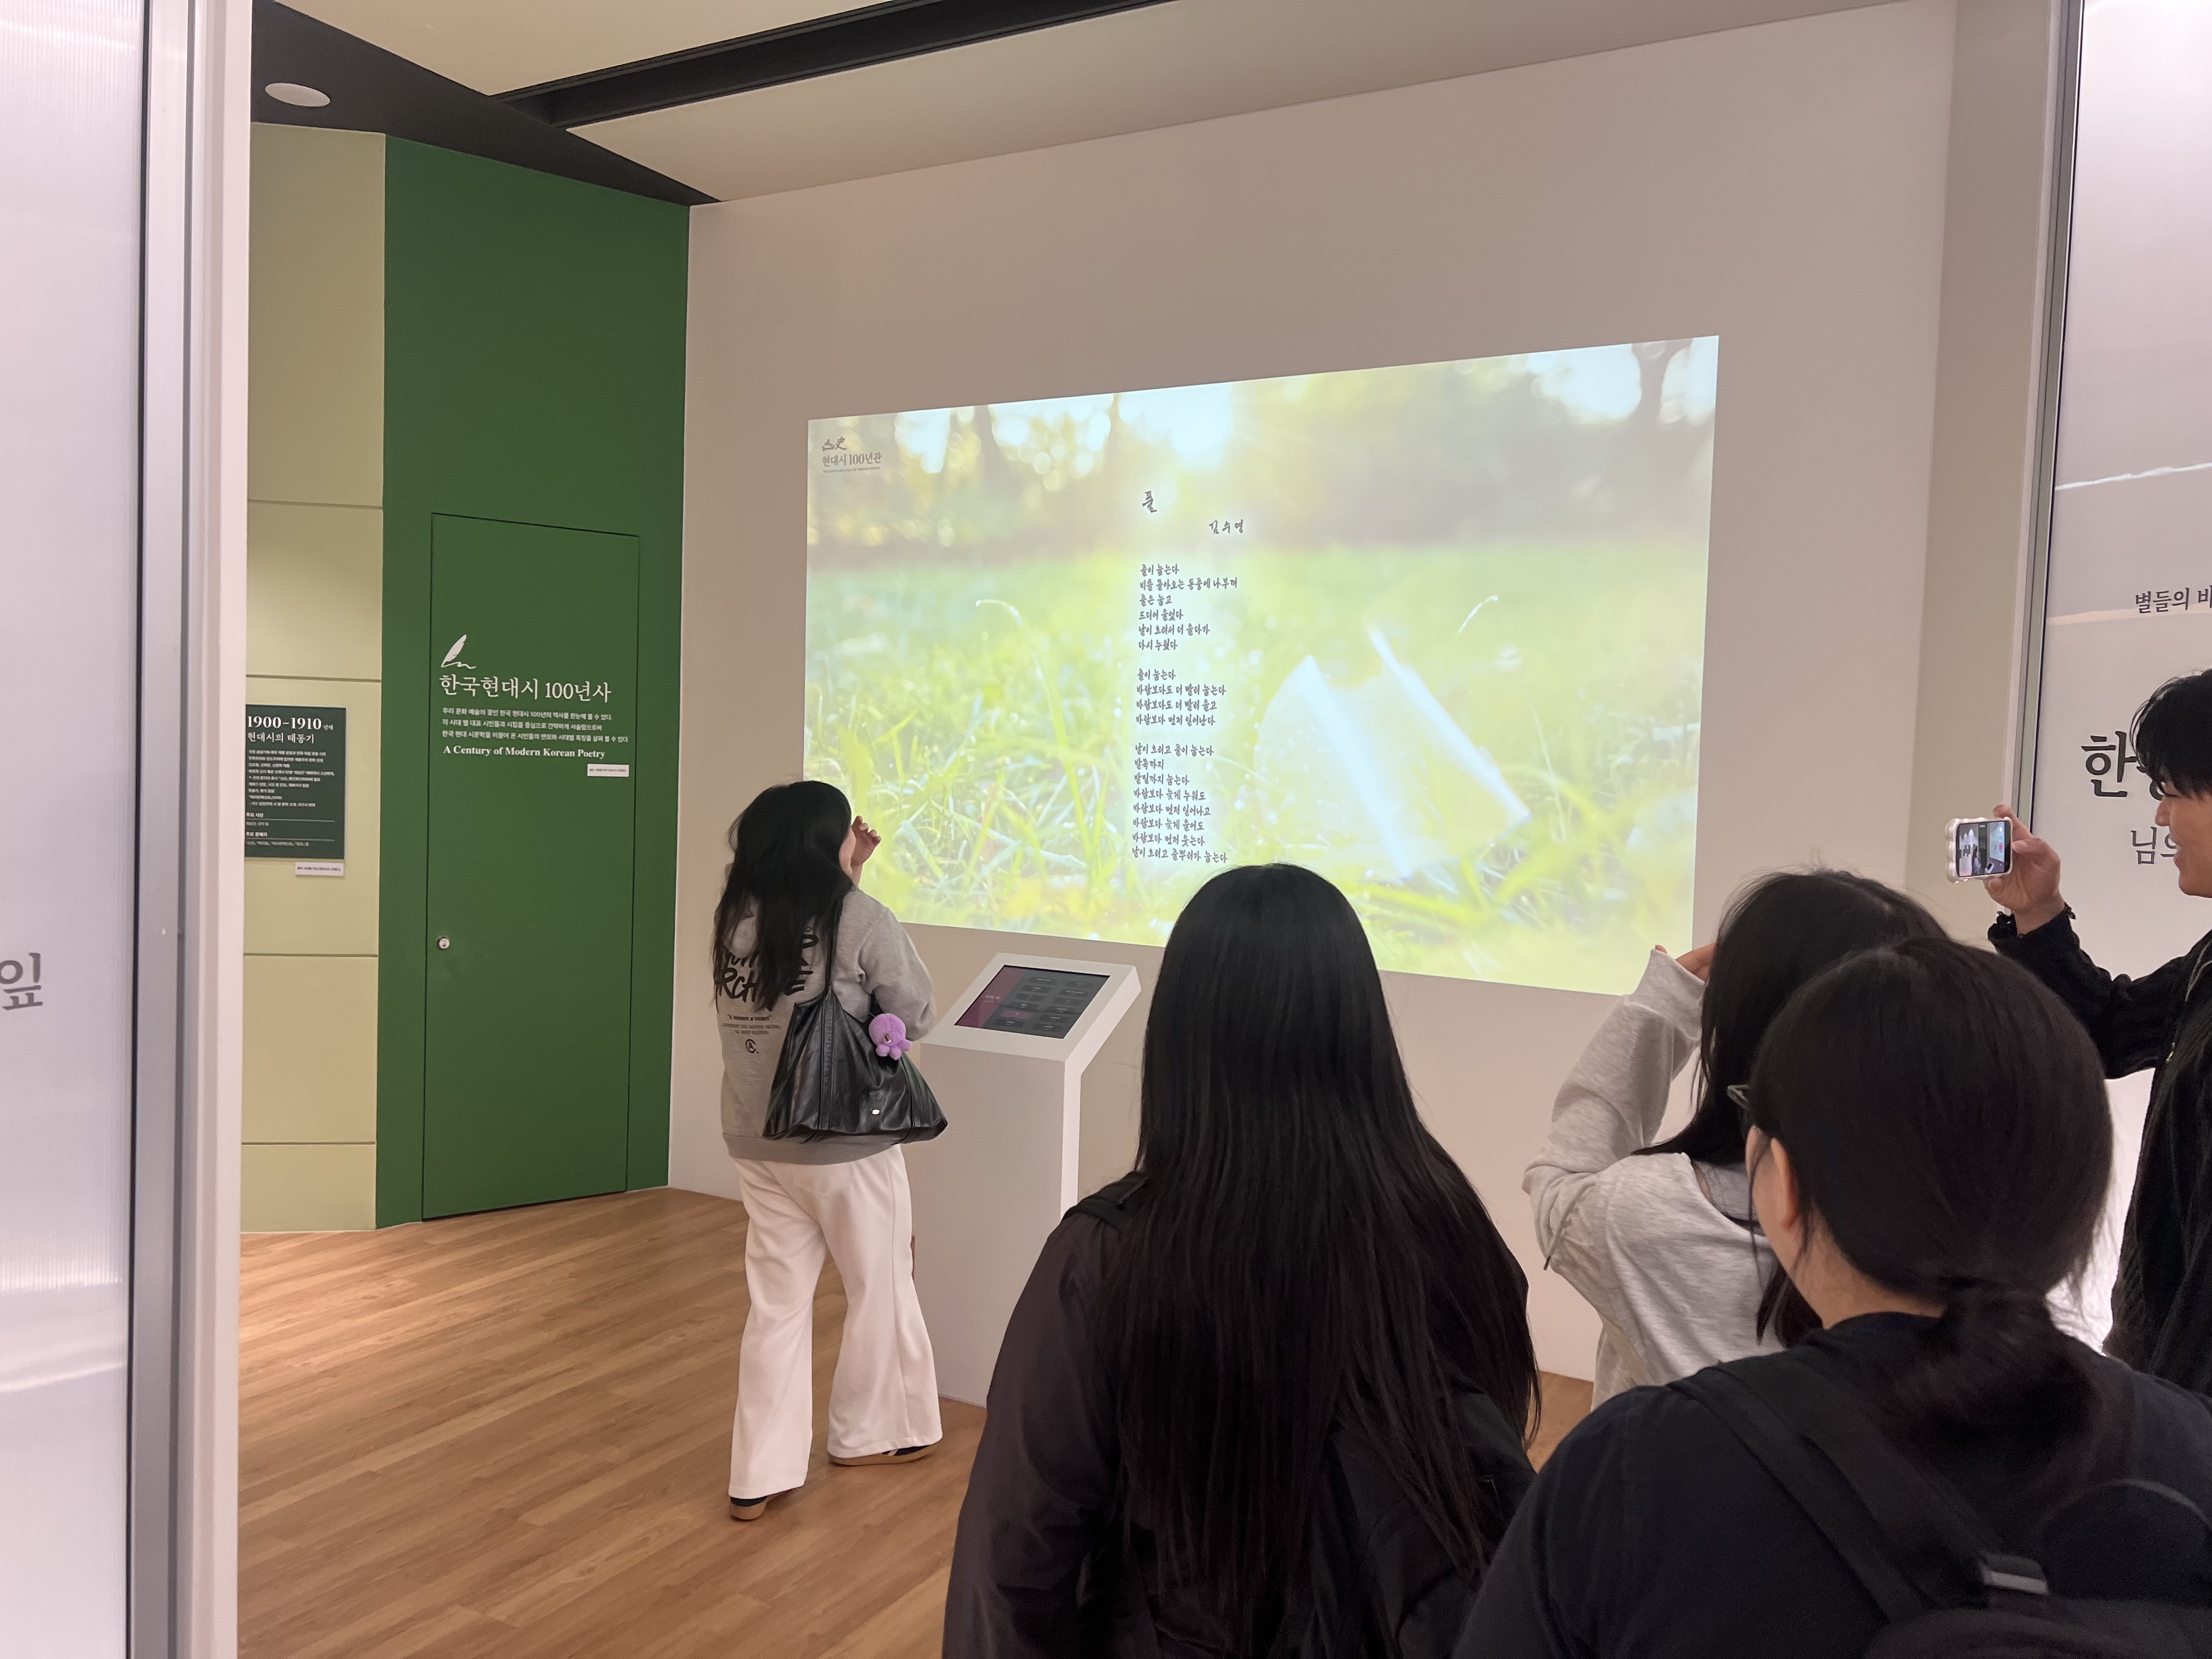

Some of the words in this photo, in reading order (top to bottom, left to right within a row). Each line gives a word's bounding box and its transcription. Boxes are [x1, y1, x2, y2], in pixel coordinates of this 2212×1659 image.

[822, 454, 847, 467] 현대시
[849, 452, 882, 465] 100년관
[1142, 491, 1157, 512] 풀
[1141, 564, 1154, 577] 풀이
[1156, 564, 1179, 575] 눕는다
[1140, 579, 1154, 590] 비를
[1156, 579, 1185, 590] 몰아오는
[1187, 578, 1210, 590] 동풍에
[1139, 594, 1154, 606] 풀은
[1157, 594, 1172, 606] 눕고
[2136, 588, 2189, 613] 별들의
[1139, 610, 1159, 620] 드디어
[1161, 609, 1183, 621] 울었다
[1138, 624, 1152, 636] 날이
[1177, 625, 1183, 635] 더
[1186, 623, 1210, 635] 울다가
[1138, 640, 1153, 651] 다시
[1155, 639, 1178, 651] 누웠다
[1137, 668, 1150, 681] 풀이
[1153, 669, 1176, 681] 눕는다
[439, 674, 538, 701] 한국현대시
[545, 681, 611, 703] 100년사
[1136, 684, 1173, 696] 바람보다도
[1176, 685, 1182, 695] 더
[1185, 685, 1200, 696] 빨리
[1203, 685, 1226, 696] 눕는다
[1136, 699, 1172, 710] 바람보다도
[1176, 699, 1182, 710] 더
[1185, 699, 1199, 711] 빨리
[1202, 699, 1217, 711] 울고
[1136, 714, 1166, 725] 바람보다
[1168, 715, 1182, 726] 먼저
[1185, 714, 1216, 727] 일어난다
[247, 732, 284, 742] 현대시의
[453, 746, 491, 756] Century
[505, 747, 540, 756] Modern
[543, 748, 575, 757] Korean
[578, 749, 605, 759] Poetry
[1135, 743, 1148, 755] 날이
[1151, 744, 1171, 754] 흐리고
[1174, 744, 1188, 755] 풀이
[1190, 744, 1214, 756] 눕는다
[1135, 758, 1164, 770] 발목까지
[2081, 731, 2164, 801] 한
[1134, 772, 1164, 785] 발밑까지
[1166, 774, 1189, 786] 눕는다
[1133, 787, 1163, 799] 바람보다
[1166, 788, 1181, 800] 늦게
[1183, 789, 1206, 801] 누워도
[1133, 803, 1163, 814] 바람보다
[1166, 804, 1180, 815] 먼저
[1182, 804, 1211, 817] 일어나고
[1133, 817, 1162, 829] 바람보다
[1165, 817, 1180, 831] 늦게
[1182, 819, 1204, 831] 울어도
[1132, 832, 1162, 844] 바람보다
[1165, 833, 1179, 845] 먼저
[1182, 834, 1205, 847] 웃는다
[1132, 846, 1145, 859] 날이
[1148, 848, 1168, 859] 흐리고
[1171, 848, 1201, 861] 풀뿌리가
[1204, 850, 1227, 864] 눕는다
[0, 952, 43, 1011] 잎
